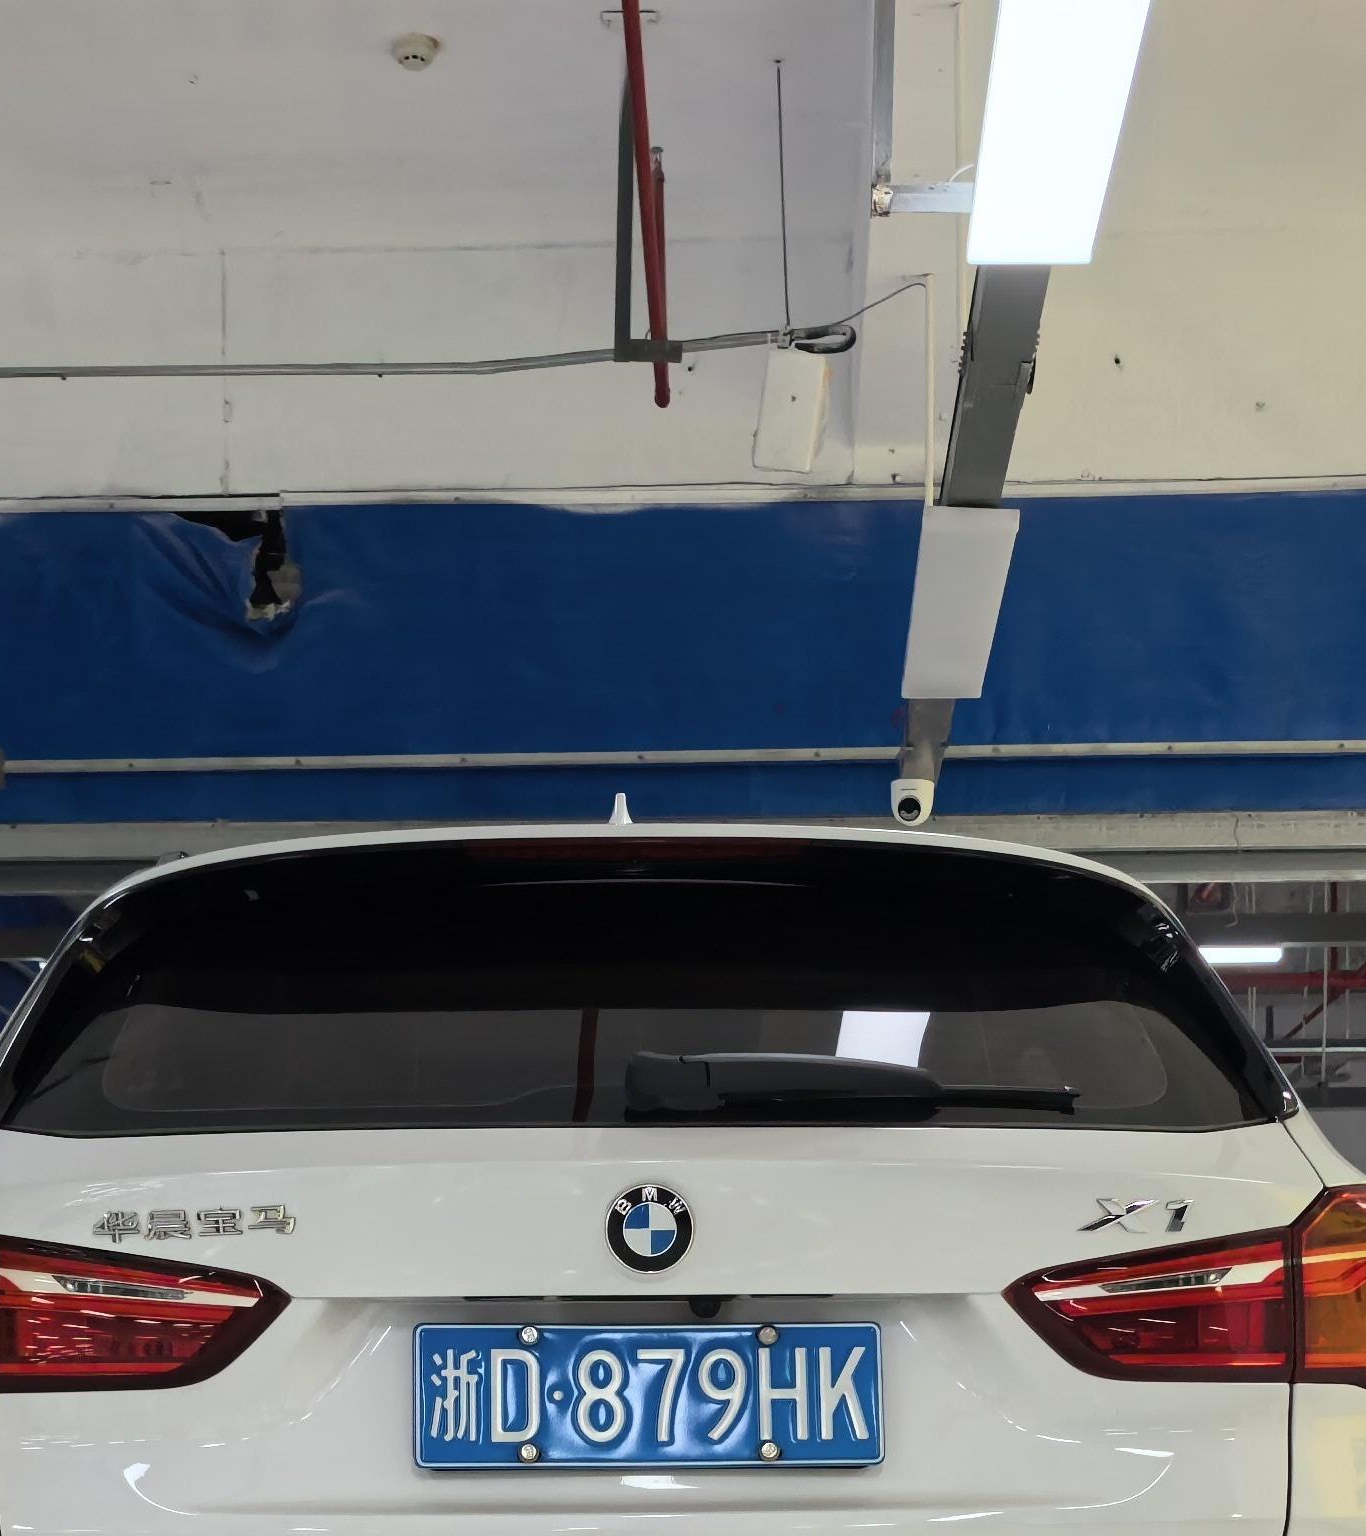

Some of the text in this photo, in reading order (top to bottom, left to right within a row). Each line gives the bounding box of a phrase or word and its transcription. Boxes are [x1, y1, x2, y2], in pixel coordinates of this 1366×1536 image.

[614, 1185, 687, 1216] BMW
[1075, 1198, 1195, 1233] X1
[91, 1204, 296, 1244] 华晨宝马
